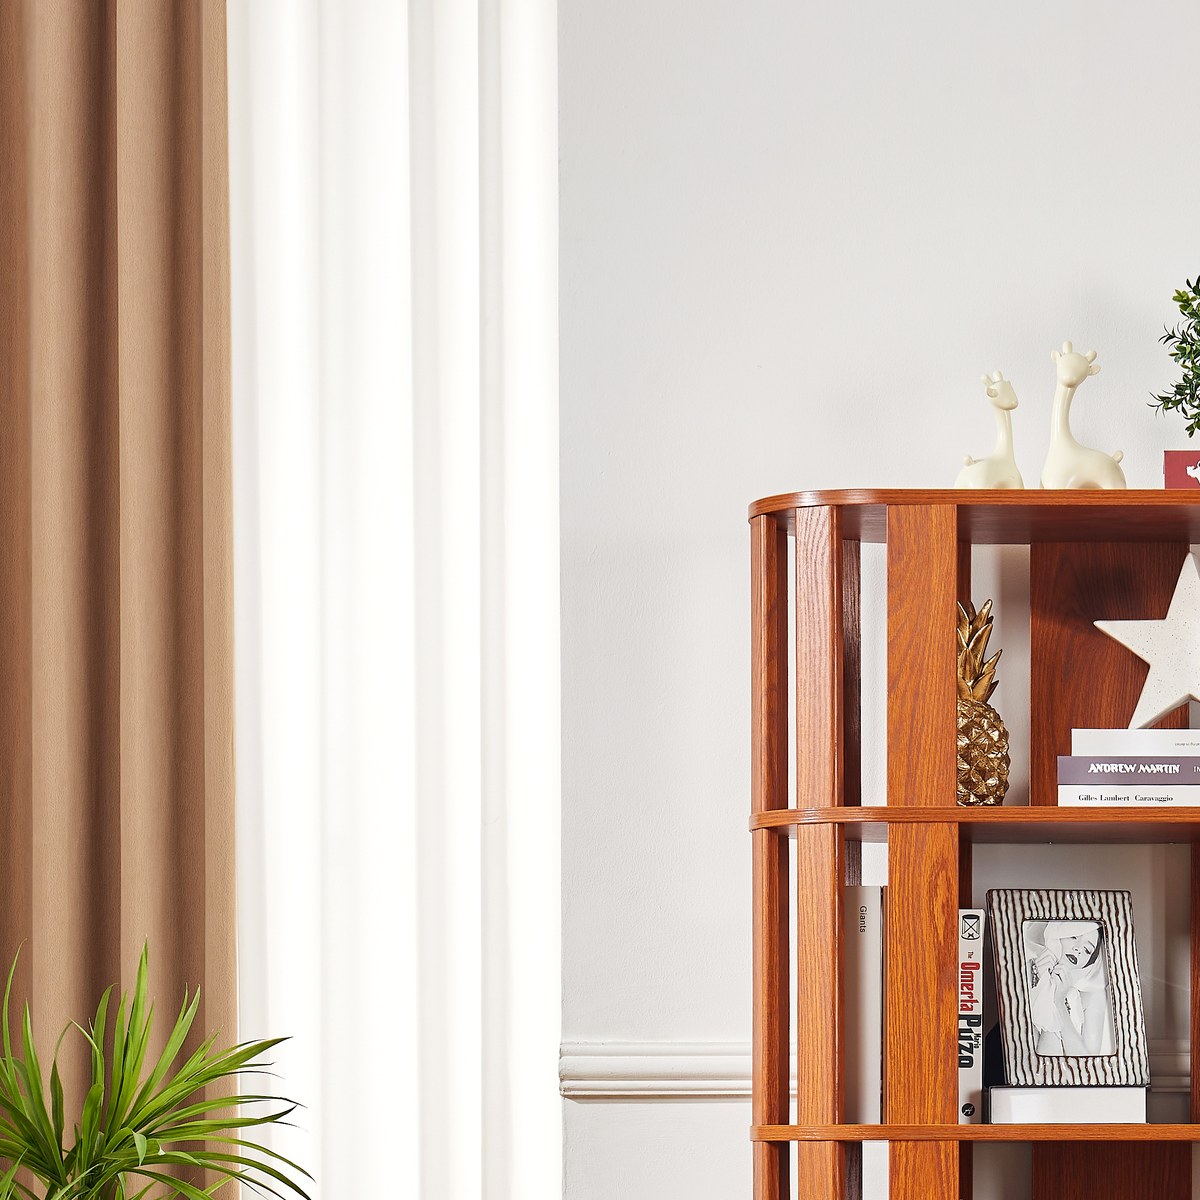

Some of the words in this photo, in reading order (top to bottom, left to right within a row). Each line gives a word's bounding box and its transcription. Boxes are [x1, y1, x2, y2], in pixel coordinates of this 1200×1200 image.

[1087, 763, 1137, 774] ANDREW
[1137, 763, 1181, 774] MARTIN
[1078, 793, 1098, 802] Gilles
[1100, 793, 1130, 802] Lambert
[1134, 793, 1174, 803] Caravaggio
[859, 905, 867, 933] Giants
[960, 961, 981, 1012] Omerta
[958, 1013, 982, 1068] Puzo
[973, 1033, 982, 1049] Mario
